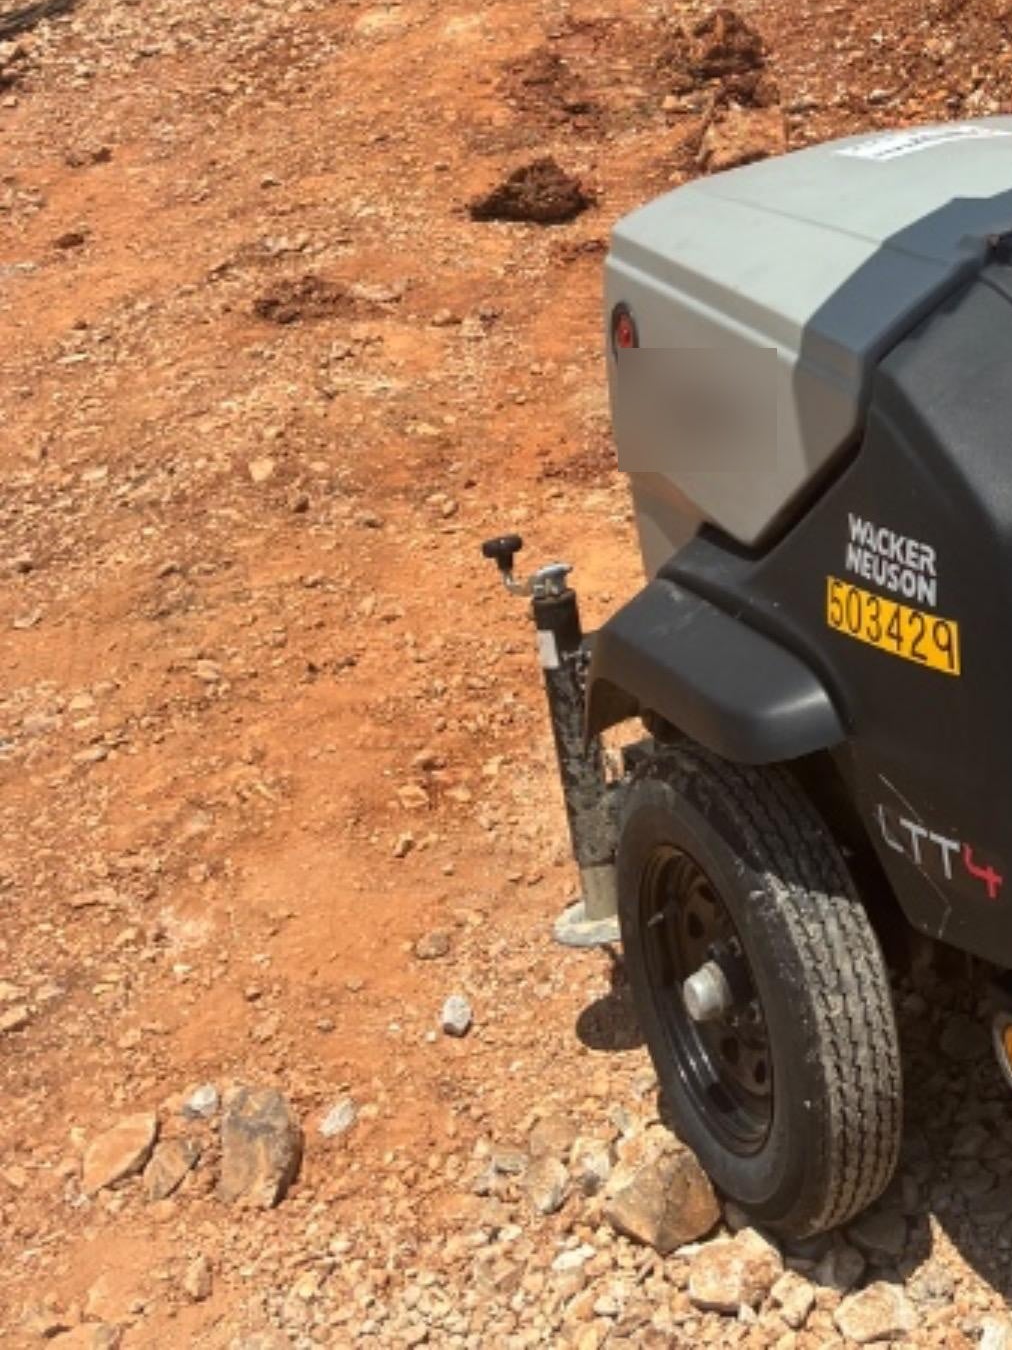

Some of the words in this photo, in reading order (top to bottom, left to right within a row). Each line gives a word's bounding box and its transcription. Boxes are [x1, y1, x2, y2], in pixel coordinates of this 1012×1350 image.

[845, 542, 937, 607] NEUSON
[848, 512, 937, 576] WACKER
[829, 581, 955, 670] 503429
[876, 803, 1003, 899] LTT4
